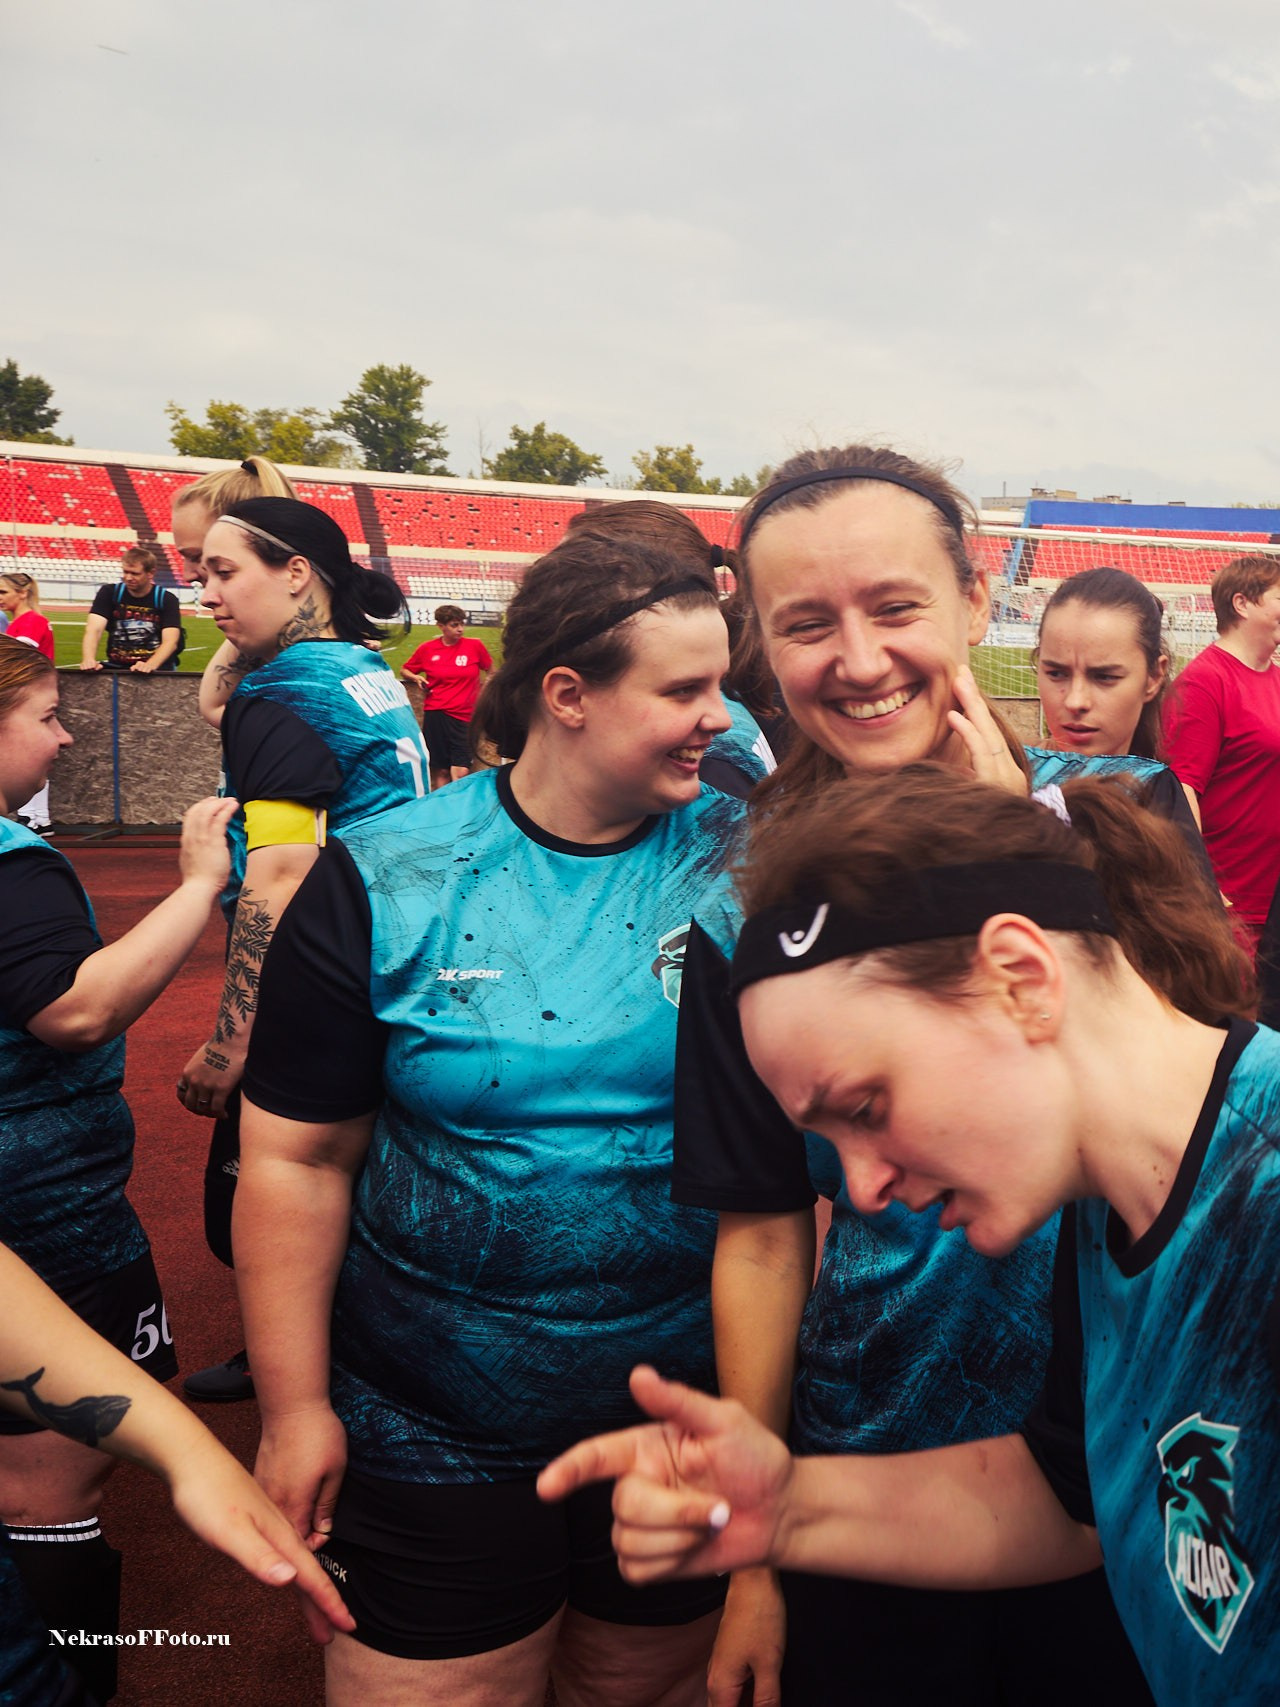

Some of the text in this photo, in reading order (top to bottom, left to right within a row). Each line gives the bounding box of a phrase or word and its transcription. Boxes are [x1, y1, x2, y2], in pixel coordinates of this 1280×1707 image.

[455, 655, 468, 667] 69
[437, 968, 504, 981] 2K SPORT
[314, 1552, 348, 1583] TRICK
[1175, 1531, 1241, 1600] ALTAIR
